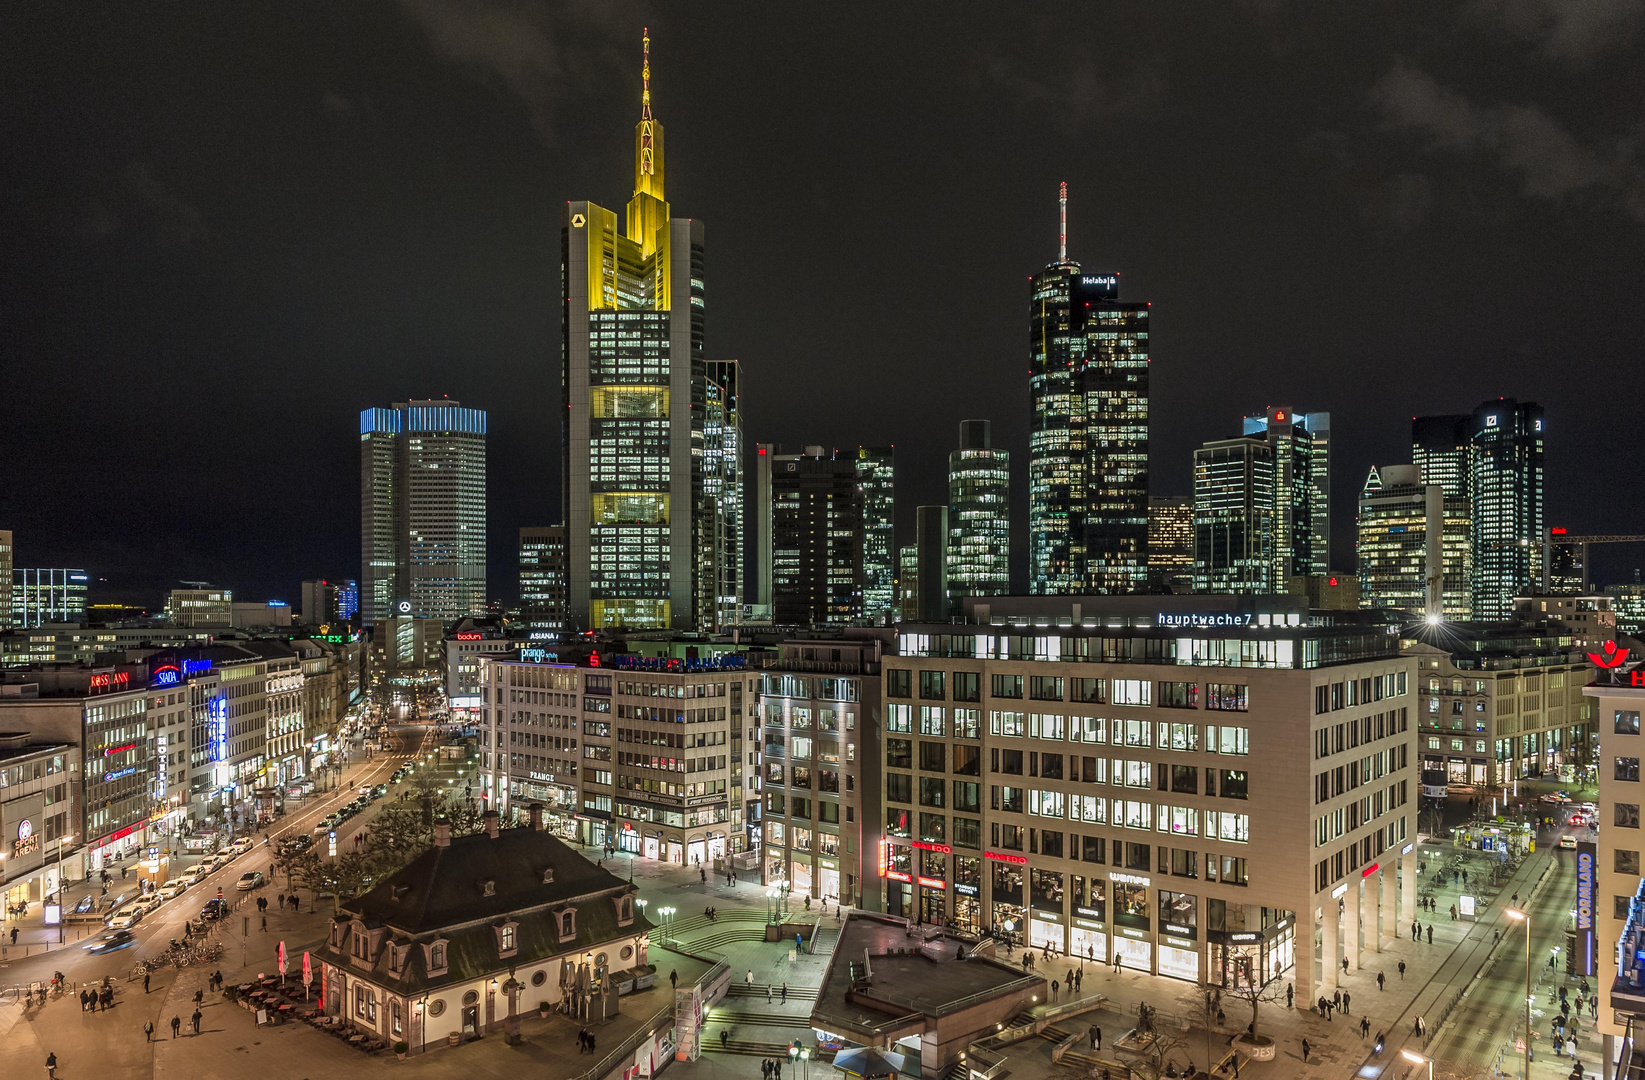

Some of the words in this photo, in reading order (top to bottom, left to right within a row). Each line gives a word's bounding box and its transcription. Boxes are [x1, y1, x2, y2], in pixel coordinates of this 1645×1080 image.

[1082, 276, 1107, 284] Helaba
[457, 633, 482, 641] bodum
[529, 632, 555, 640] ASIANA
[521, 648, 545, 664] prange
[159, 671, 177, 684] STADA
[529, 771, 555, 782] PRANGE
[15, 833, 39, 850] SPORT
[912, 841, 951, 854] MAREDO
[14, 843, 39, 859] ARENA
[984, 851, 1028, 865] MAREDO
[1578, 852, 1593, 930] WORMLAND
